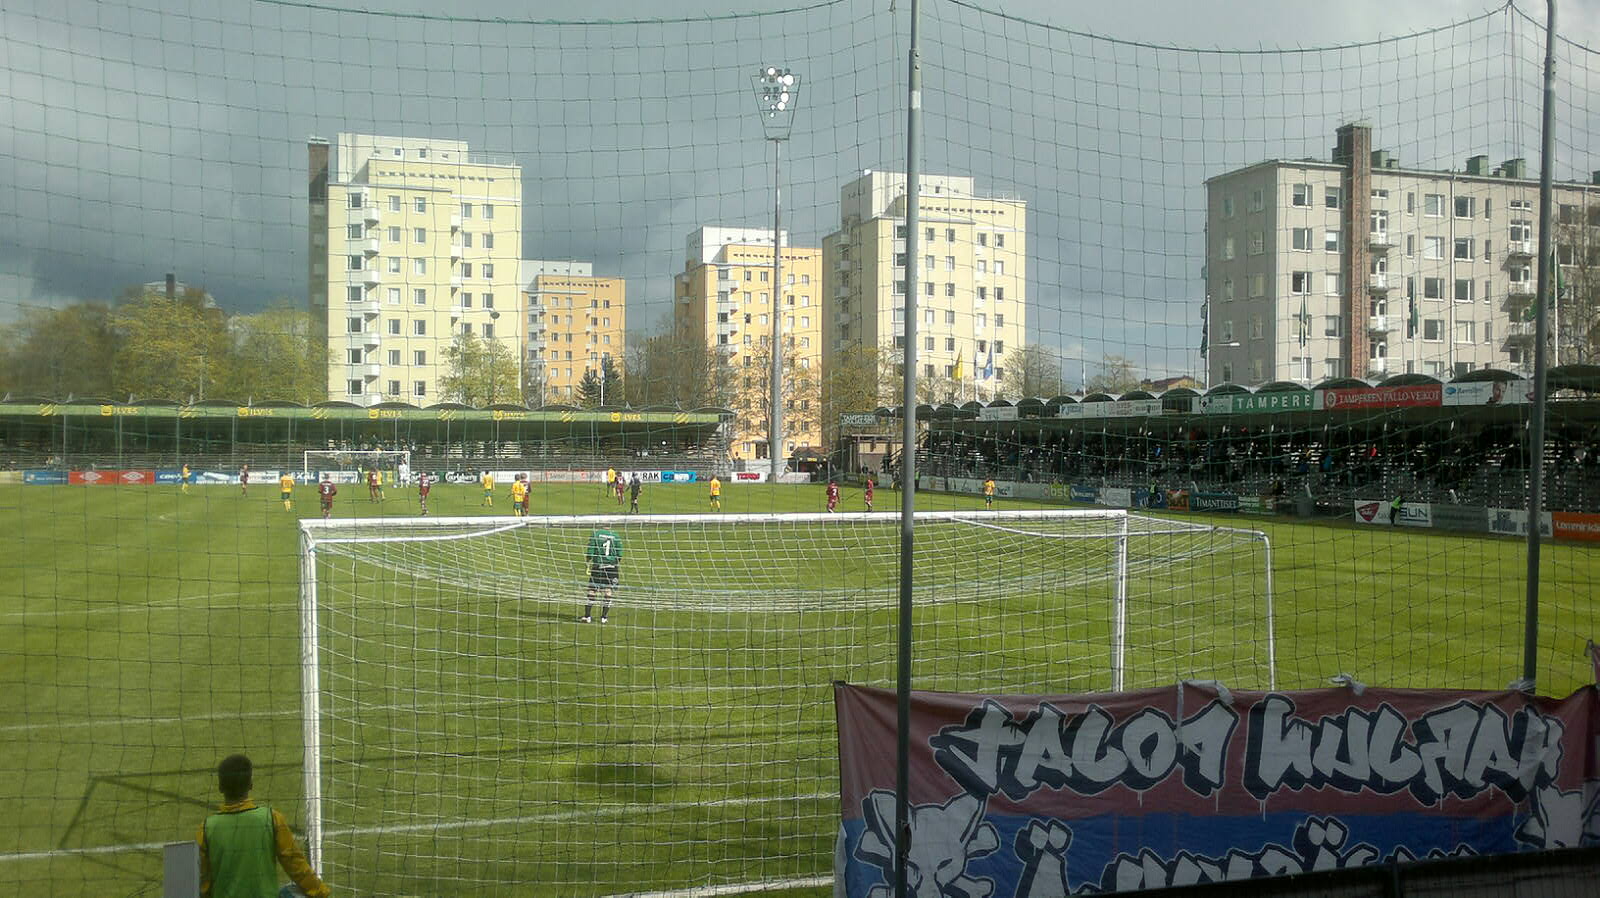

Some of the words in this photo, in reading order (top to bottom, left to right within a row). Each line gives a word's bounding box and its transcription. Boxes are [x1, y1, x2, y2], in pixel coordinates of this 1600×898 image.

[1237, 395, 1311, 409] TAMPERE
[445, 472, 477, 482] Carlsberg
[323, 486, 330, 495] 3
[602, 540, 610, 556] 1
